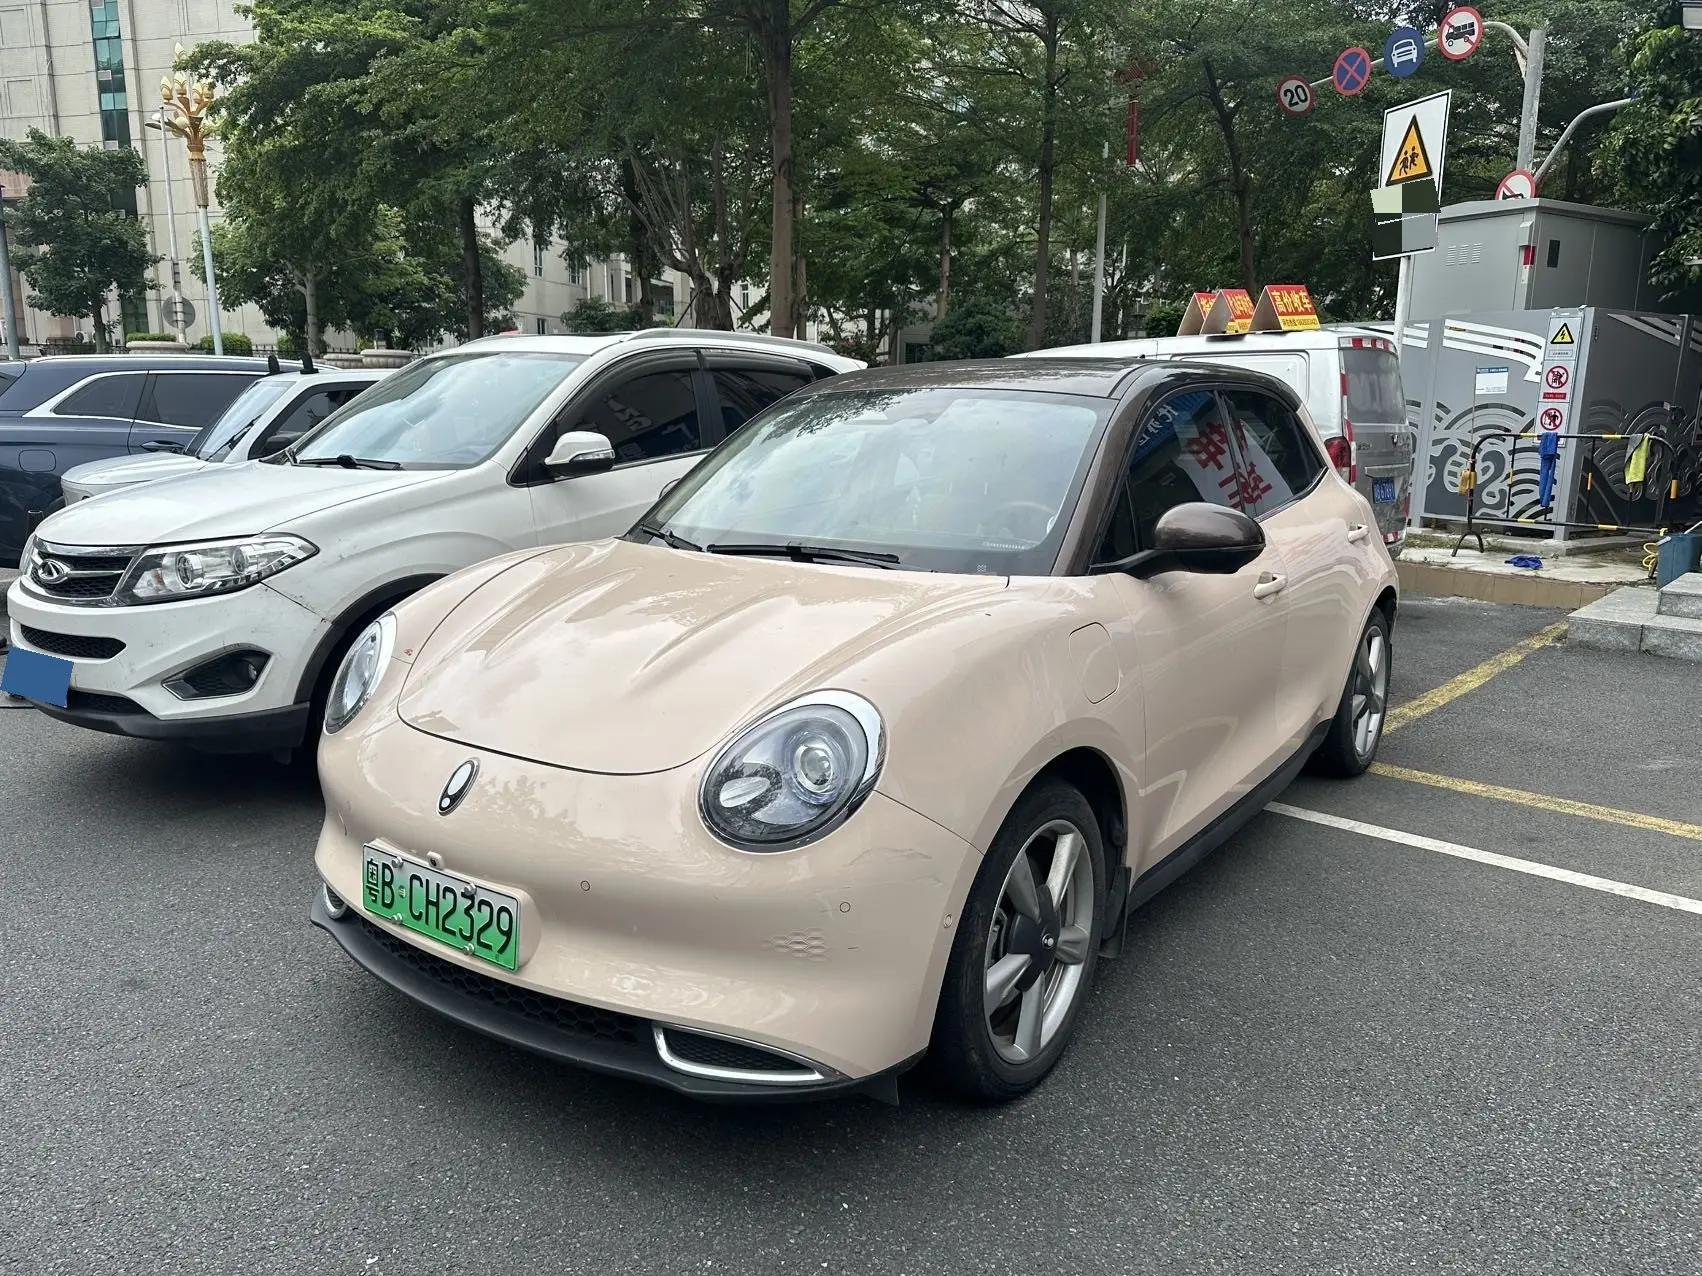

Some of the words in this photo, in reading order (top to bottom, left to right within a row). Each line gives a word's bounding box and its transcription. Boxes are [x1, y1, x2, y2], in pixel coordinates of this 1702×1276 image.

[1283, 85, 1308, 107] 20
[1271, 290, 1313, 313] 高价收车
